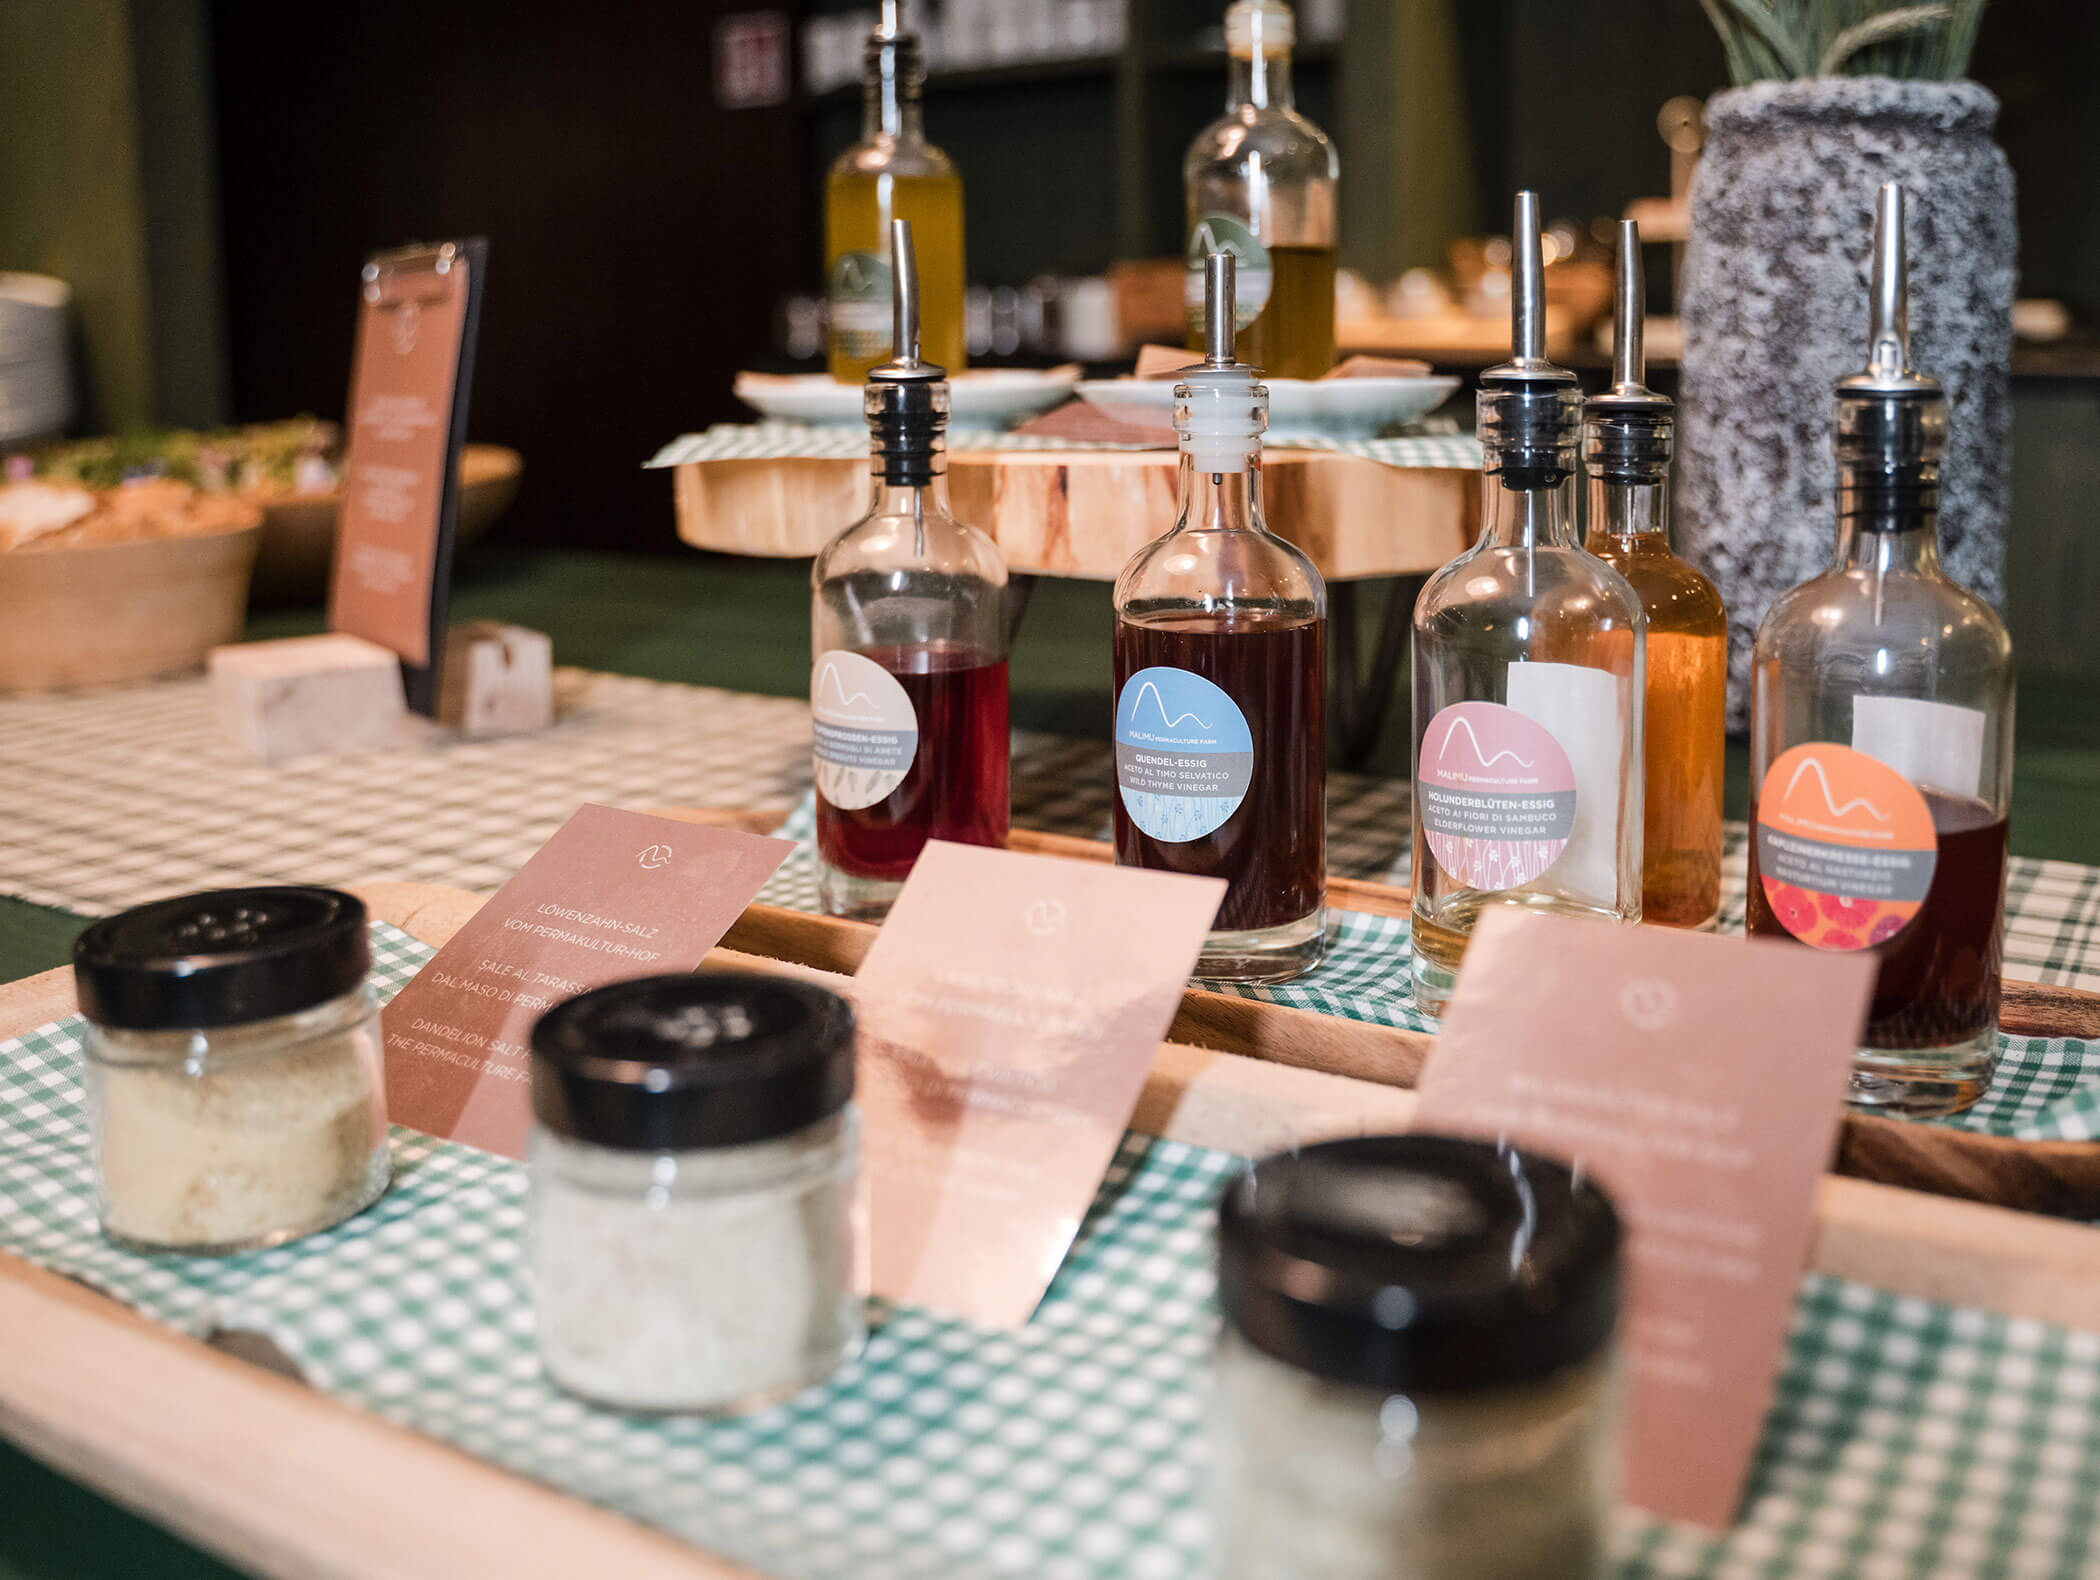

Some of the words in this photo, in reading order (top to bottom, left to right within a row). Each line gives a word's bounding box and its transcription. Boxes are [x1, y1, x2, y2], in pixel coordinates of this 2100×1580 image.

[1155, 735, 1198, 745] PERMACULTURE
[1135, 754, 1208, 768] QUENDEL-ESSIG
[1123, 764, 1143, 775] ACETO
[1144, 768, 1155, 777] AL
[1156, 769, 1177, 779] TIMO
[1179, 771, 1230, 780] SELVATICO
[1129, 776, 1147, 786] WILD
[1148, 779, 1175, 791] THYME
[1176, 783, 1219, 793] VINEGAR
[1428, 791, 1555, 809] HOLUNDERBLÜTEN-ESSIG
[1428, 804, 1450, 817] ACETO
[1463, 811, 1489, 822] FIORI
[1491, 813, 1503, 822] DI
[1505, 813, 1557, 823] SAMBUCO
[1433, 818, 1497, 834] ELDERFLOWER
[1499, 825, 1547, 835] VINEGAR
[537, 903, 660, 939] LÖWENZAHN-SALZ
[503, 918, 534, 934] VOM
[533, 924, 662, 962] PERMAKULTUR-HOF
[478, 959, 514, 977] SALE
[511, 968, 530, 982] AL
[431, 972, 457, 988] DAL
[458, 980, 499, 998] MASO
[498, 989, 515, 1002] DI
[411, 1017, 489, 1049] DANDELION
[487, 1039, 525, 1058] SALT
[385, 1032, 415, 1050] THE
[411, 1041, 516, 1080] PERMACULTURE
